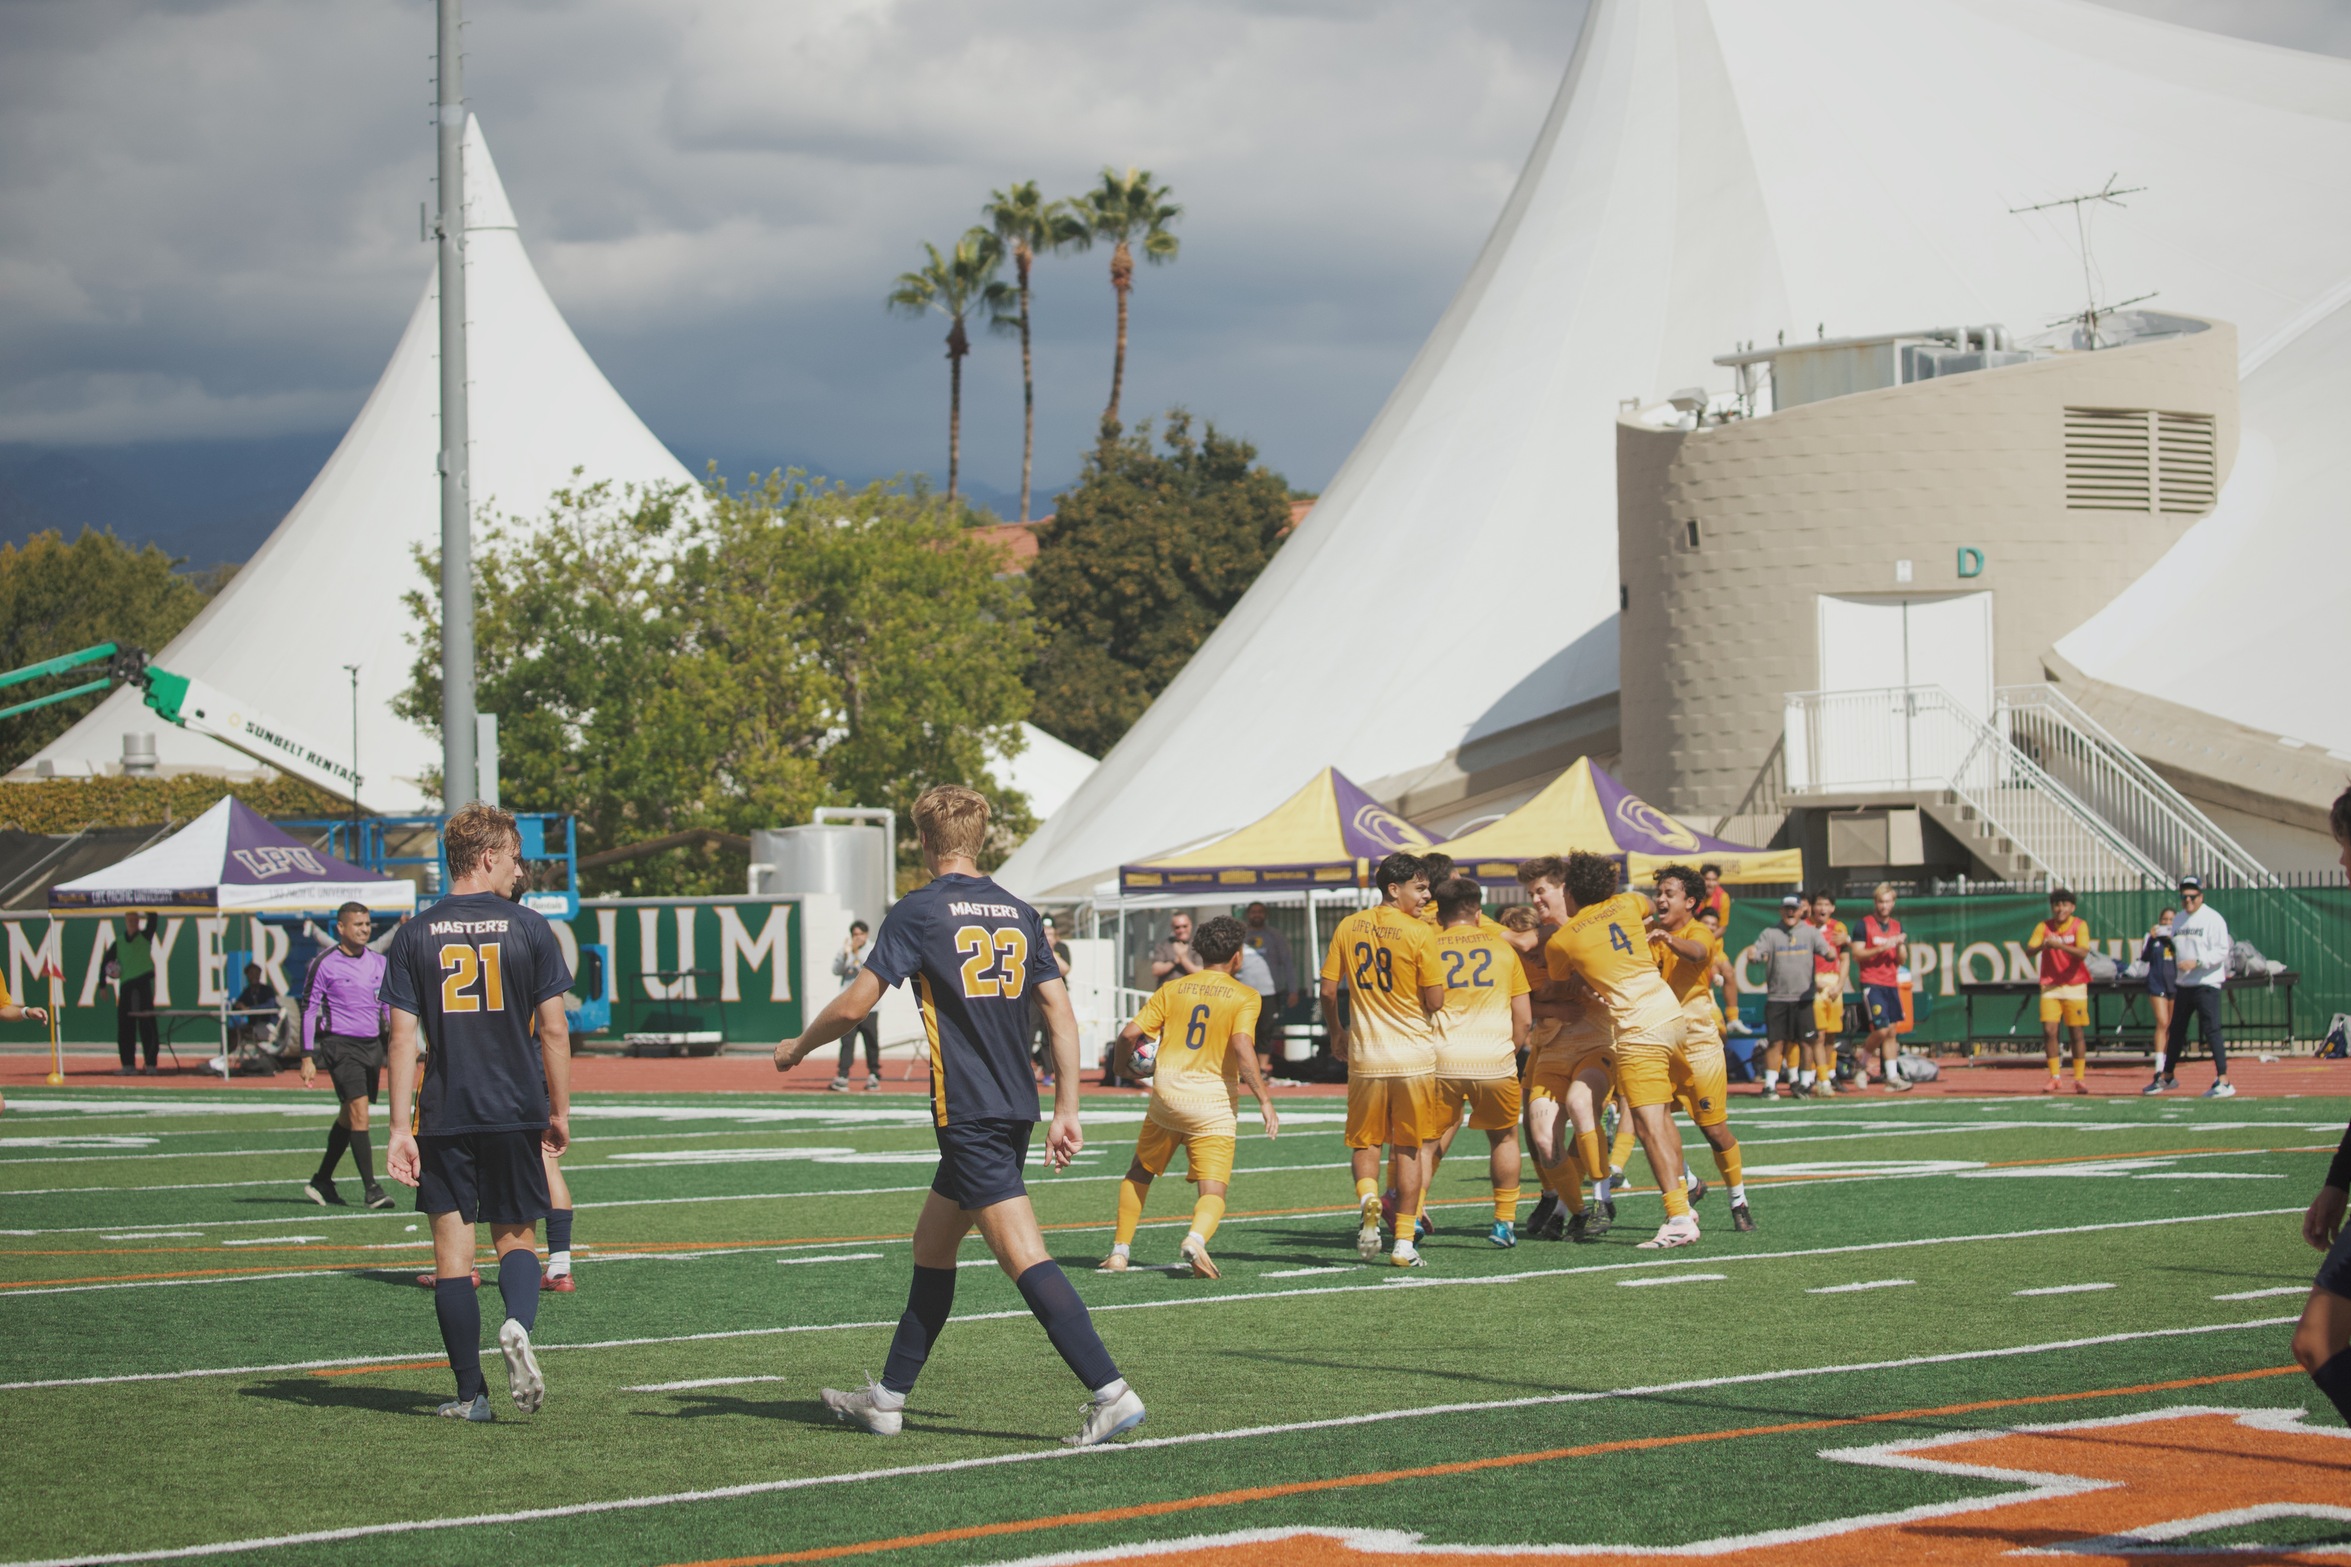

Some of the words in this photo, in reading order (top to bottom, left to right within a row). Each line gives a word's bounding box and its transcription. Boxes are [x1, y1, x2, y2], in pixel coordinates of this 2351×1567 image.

[1957, 546, 1985, 578] D
[245, 721, 304, 758] SUNBELT
[306, 750, 365, 788] RENTALS
[233, 847, 328, 879] LPU
[318, 886, 363, 898] UNIVERSITY
[947, 902, 1019, 920] MASTER'S
[1352, 919, 1370, 935] LIFE
[1571, 917, 1595, 934] LIFE
[429, 920, 509, 936] MASTER'S
[1455, 933, 1493, 944] PACIFIC
[1608, 922, 1634, 955] 4
[438, 942, 505, 1014] 21
[953, 925, 1028, 999] 23
[1354, 941, 1394, 993] 28
[1440, 948, 1495, 989] 22
[1178, 983, 1200, 995] LIFE
[1199, 984, 1235, 999] PACIFIC
[1185, 1003, 1211, 1051] 6
